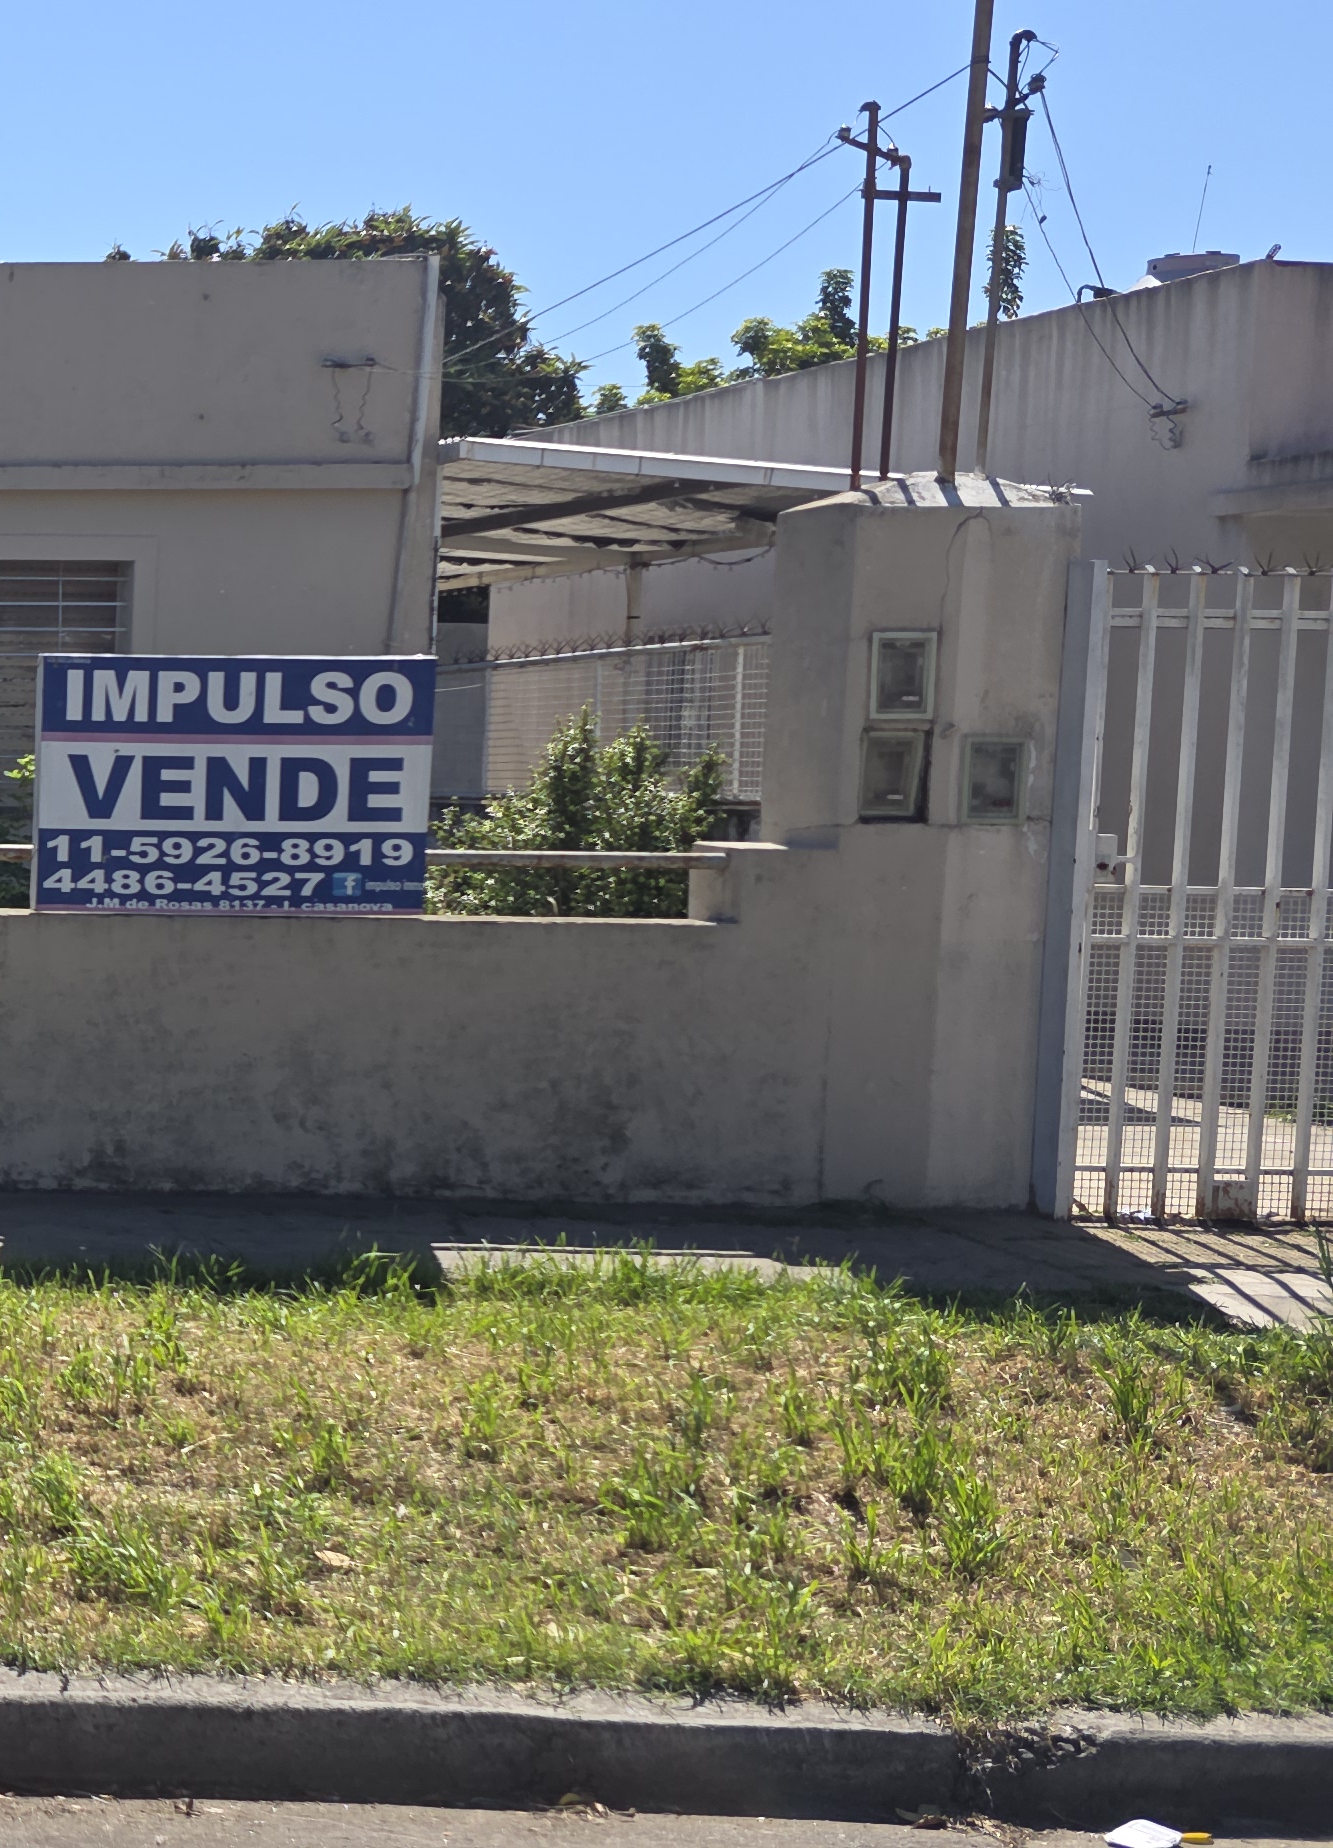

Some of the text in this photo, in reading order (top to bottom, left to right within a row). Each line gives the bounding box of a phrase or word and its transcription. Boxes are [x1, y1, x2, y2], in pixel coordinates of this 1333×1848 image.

[65, 669, 414, 725] IMPULSO
[67, 753, 404, 822] VENDE
[46, 834, 414, 866] 11-5926-8919
[43, 868, 325, 896] 4486-4527
[126, 899, 149, 909] de
[155, 899, 213, 910] Rosas
[219, 900, 266, 911] 8137
[301, 902, 393, 912] casanova
